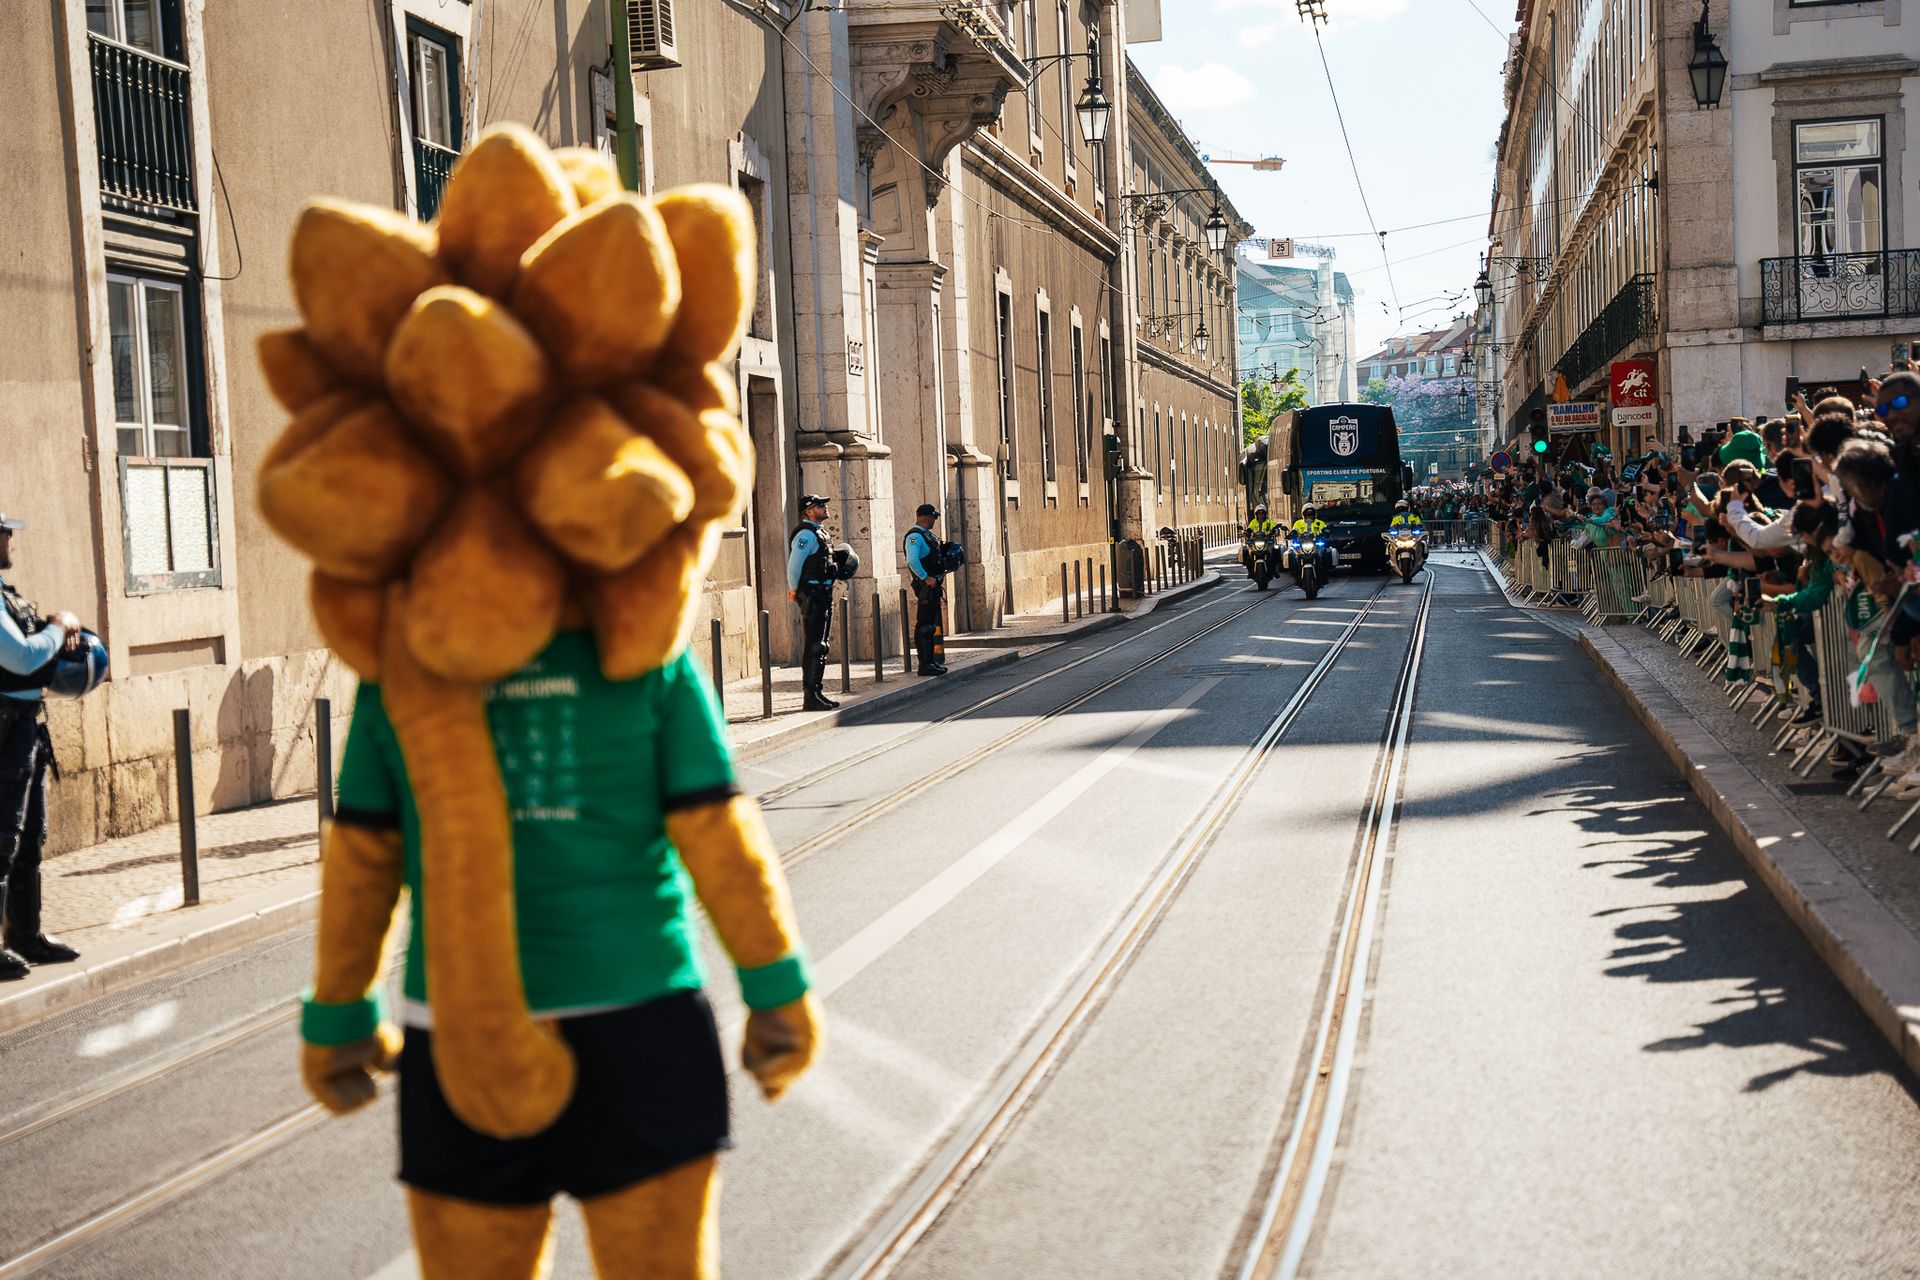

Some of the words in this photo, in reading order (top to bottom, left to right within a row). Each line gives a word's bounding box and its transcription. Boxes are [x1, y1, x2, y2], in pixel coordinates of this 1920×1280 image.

[1277, 243, 1285, 252] 25
[1633, 389, 1648, 397] ctt
[1617, 412, 1652, 421] bancoctt
